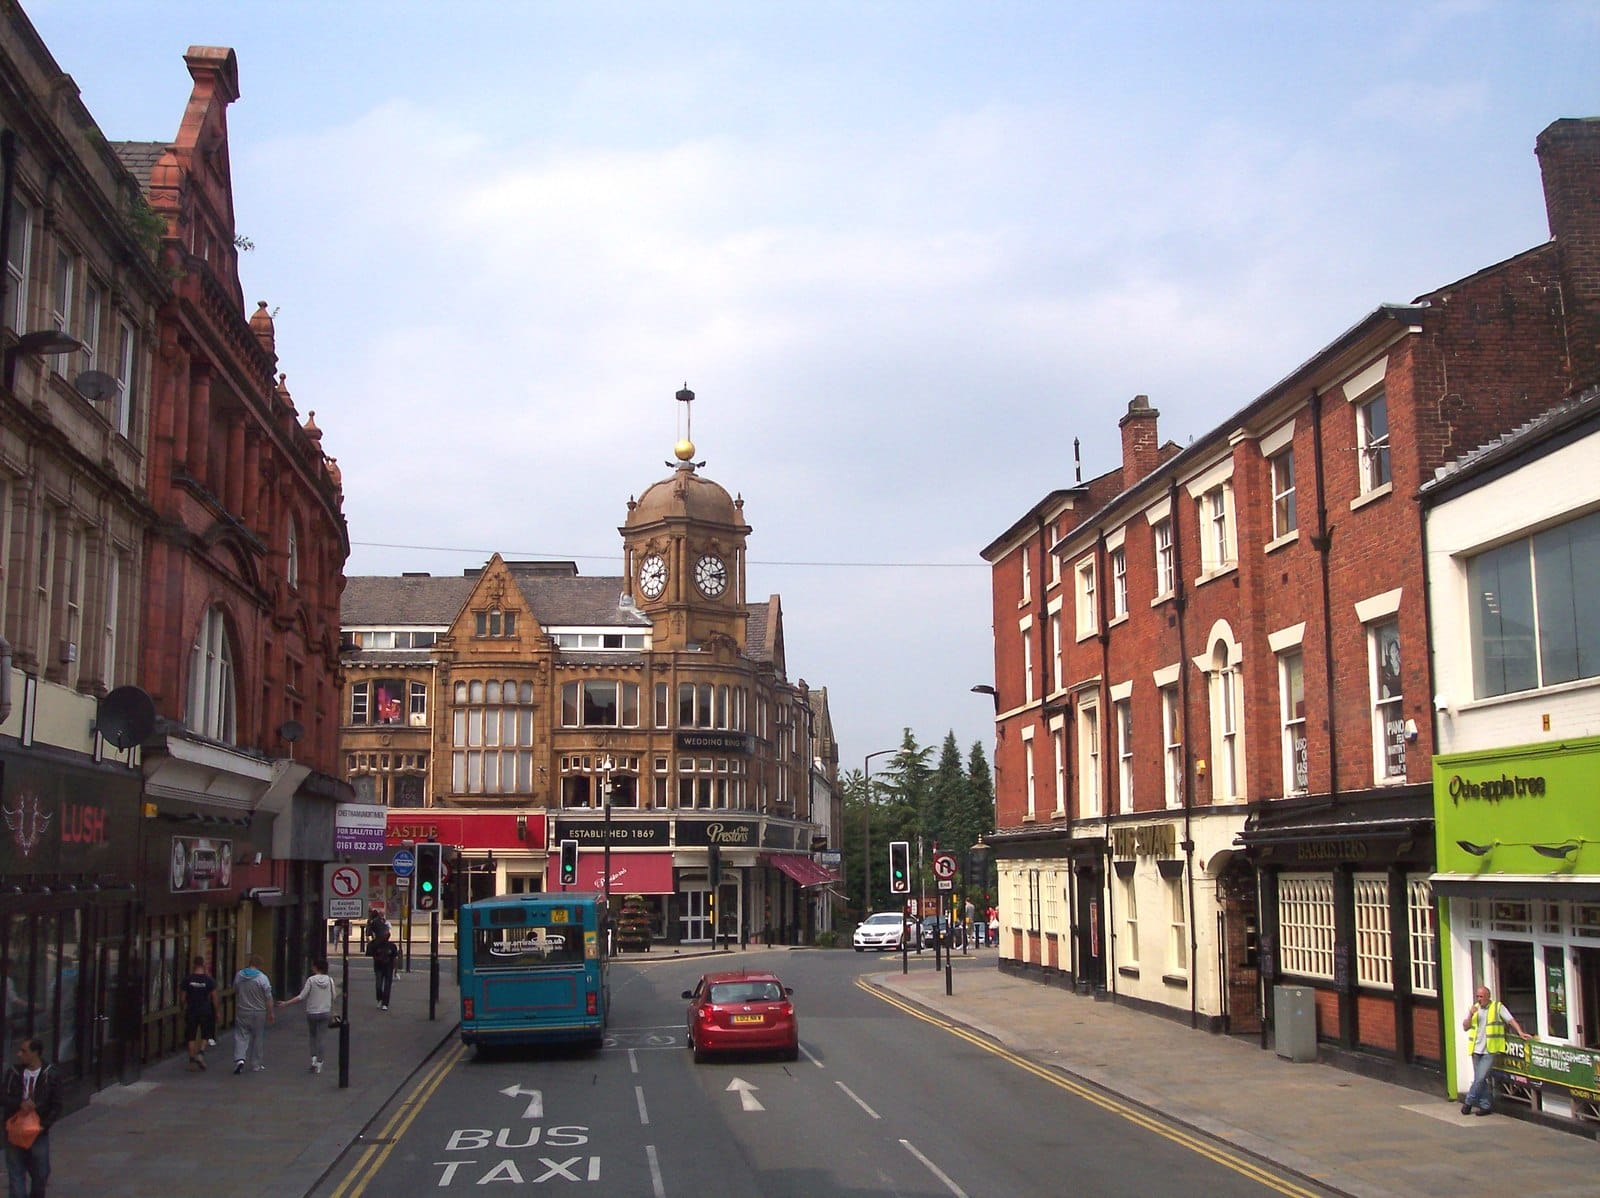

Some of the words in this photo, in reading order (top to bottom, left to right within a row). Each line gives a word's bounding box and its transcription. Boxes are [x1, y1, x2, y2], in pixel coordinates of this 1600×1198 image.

[684, 737, 722, 746] WEDDING
[1462, 780, 1480, 800] the
[1480, 773, 1514, 803] apple
[1515, 775, 1546, 798] tree
[61, 802, 105, 847] LUSH
[569, 830, 628, 838] ESTABLIHED
[632, 830, 655, 838] 1869
[706, 822, 748, 843] Prestons
[336, 841, 352, 850] 0161
[354, 842, 366, 850] 832
[367, 842, 384, 851] 3375
[1297, 840, 1368, 860] BARRISTERS
[1505, 1042, 1524, 1058] ORTS
[1531, 1045, 1549, 1057] GREAT
[1531, 1055, 1549, 1068] GREAT
[1550, 1058, 1571, 1073] VALUE
[445, 1125, 589, 1150] BUS
[432, 1156, 600, 1187] TAXI
